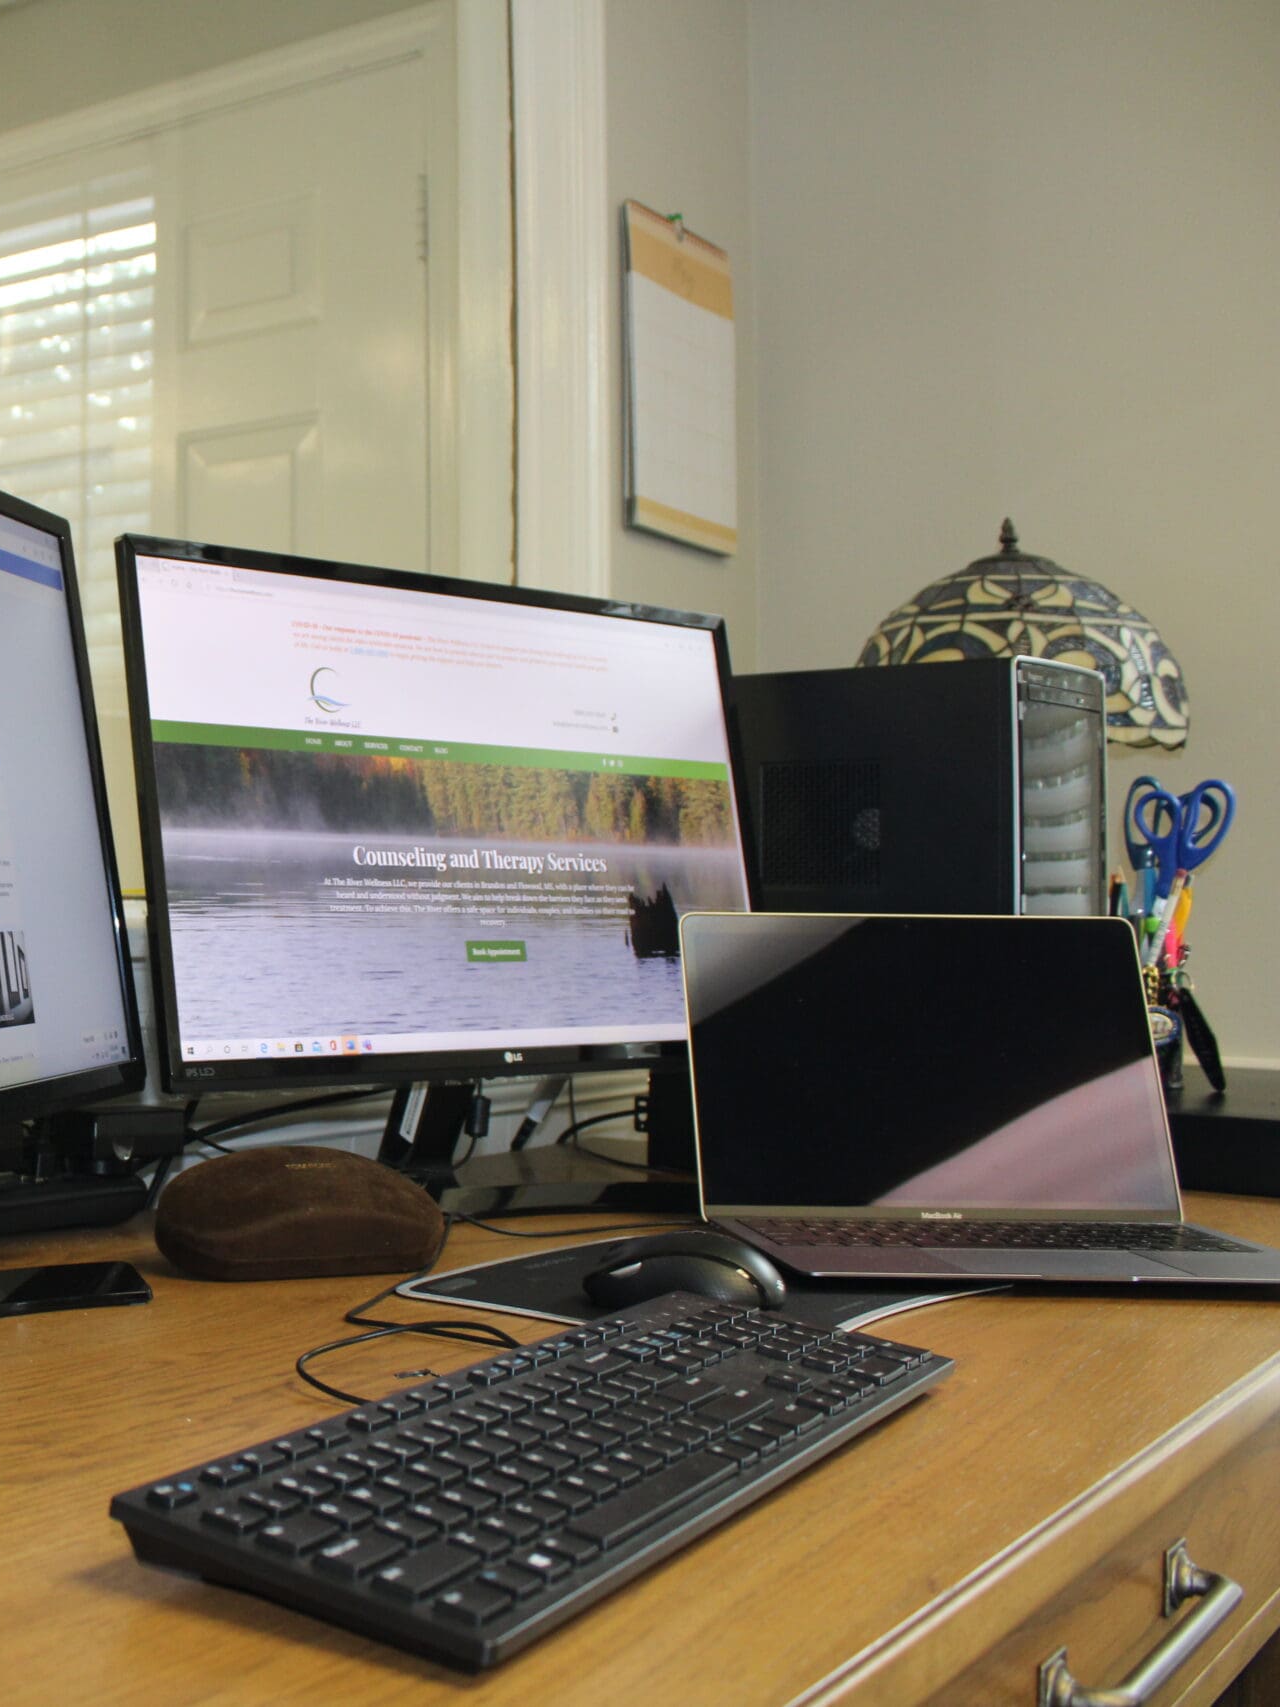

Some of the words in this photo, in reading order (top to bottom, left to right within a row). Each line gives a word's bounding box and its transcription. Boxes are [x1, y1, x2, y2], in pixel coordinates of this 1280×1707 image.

[364, 742, 389, 751] SERVICES
[400, 744, 423, 753] CONTACT
[352, 845, 448, 872] Counseling
[450, 849, 480, 869] and
[481, 849, 545, 875] Therapy
[547, 852, 609, 873] Services
[324, 877, 332, 886] At
[332, 877, 345, 887] The
[346, 877, 363, 887] River
[364, 878, 392, 888] Wellness
[418, 879, 442, 890] provide
[356, 891, 369, 900] and
[369, 891, 406, 901] understood
[374, 904, 399, 914] achieve
[414, 905, 426, 914] The
[513, 1052, 524, 1063] LG
[920, 1211, 952, 1220] MacBook
[952, 1212, 963, 1220] Air
